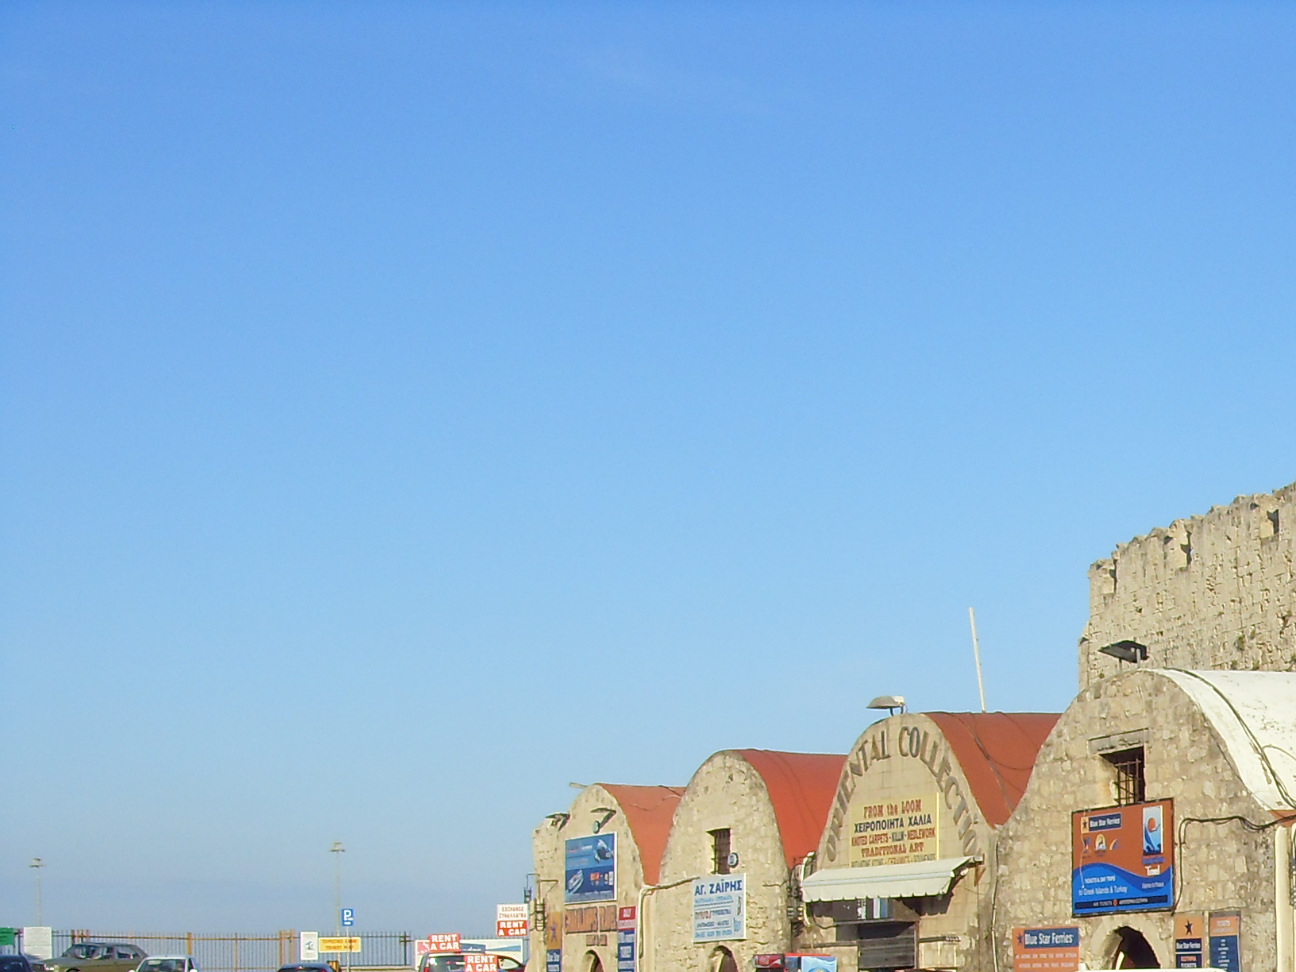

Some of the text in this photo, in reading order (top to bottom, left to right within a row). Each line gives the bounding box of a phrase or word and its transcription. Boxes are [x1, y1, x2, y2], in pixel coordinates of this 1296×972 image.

[898, 726, 980, 858] COLLECTIO
[864, 805, 884, 819] FROM
[908, 813, 932, 827] ΧΑΛΙΑ
[694, 884, 706, 896] ΑΓ.
[508, 928, 526, 936] CAR
[431, 934, 457, 943] RENT
[1024, 931, 1074, 945] Blue Star Ferries
[430, 943, 437, 951] A
[439, 942, 459, 950] CAR
[467, 955, 495, 964] RENT
[465, 963, 497, 972] A CAR
